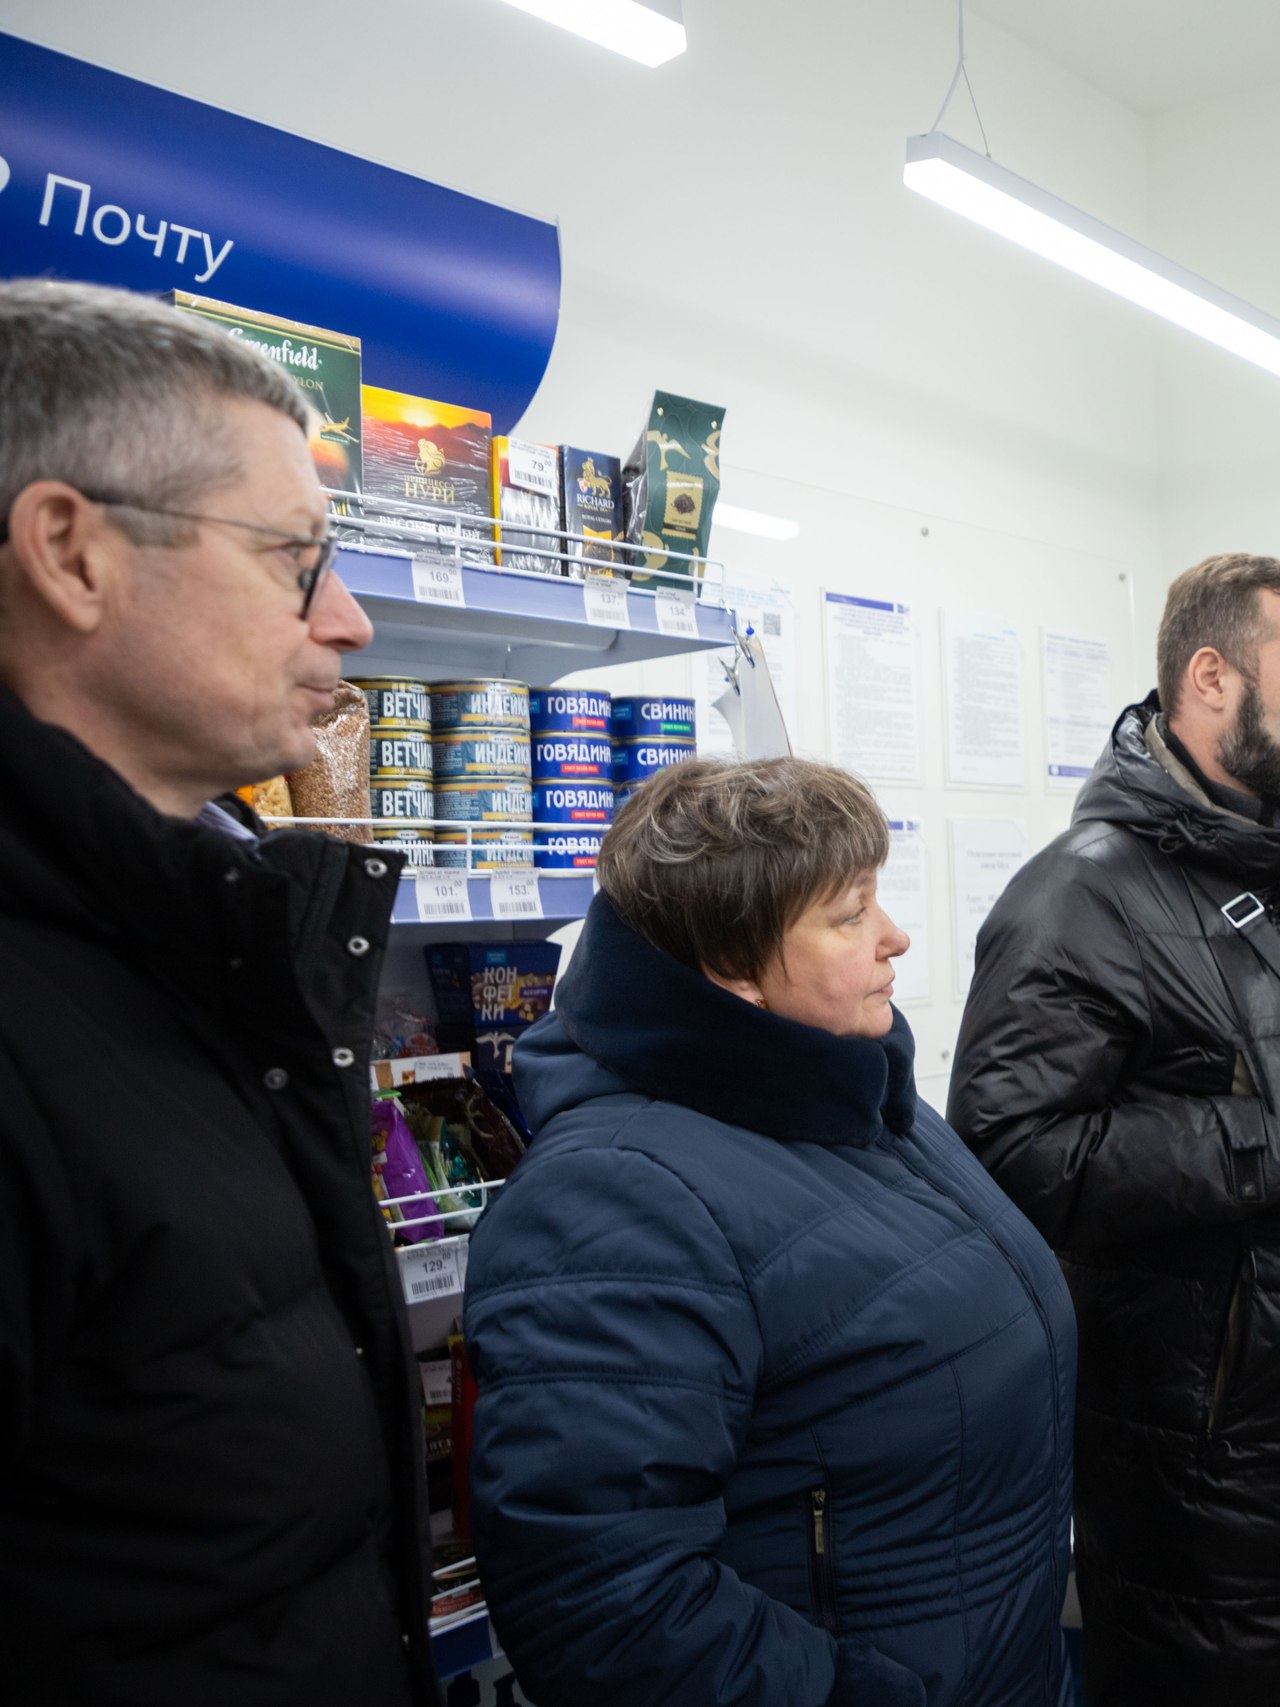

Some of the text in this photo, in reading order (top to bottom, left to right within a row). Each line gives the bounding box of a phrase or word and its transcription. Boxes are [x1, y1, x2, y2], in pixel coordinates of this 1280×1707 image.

[39, 173, 234, 283] Почту
[404, 481, 456, 505] НУРИ
[576, 492, 615, 510] RICHARD
[484, 965, 517, 985] КОН
[482, 984, 513, 1003] ФЕТ
[481, 1003, 505, 1021] КИ
